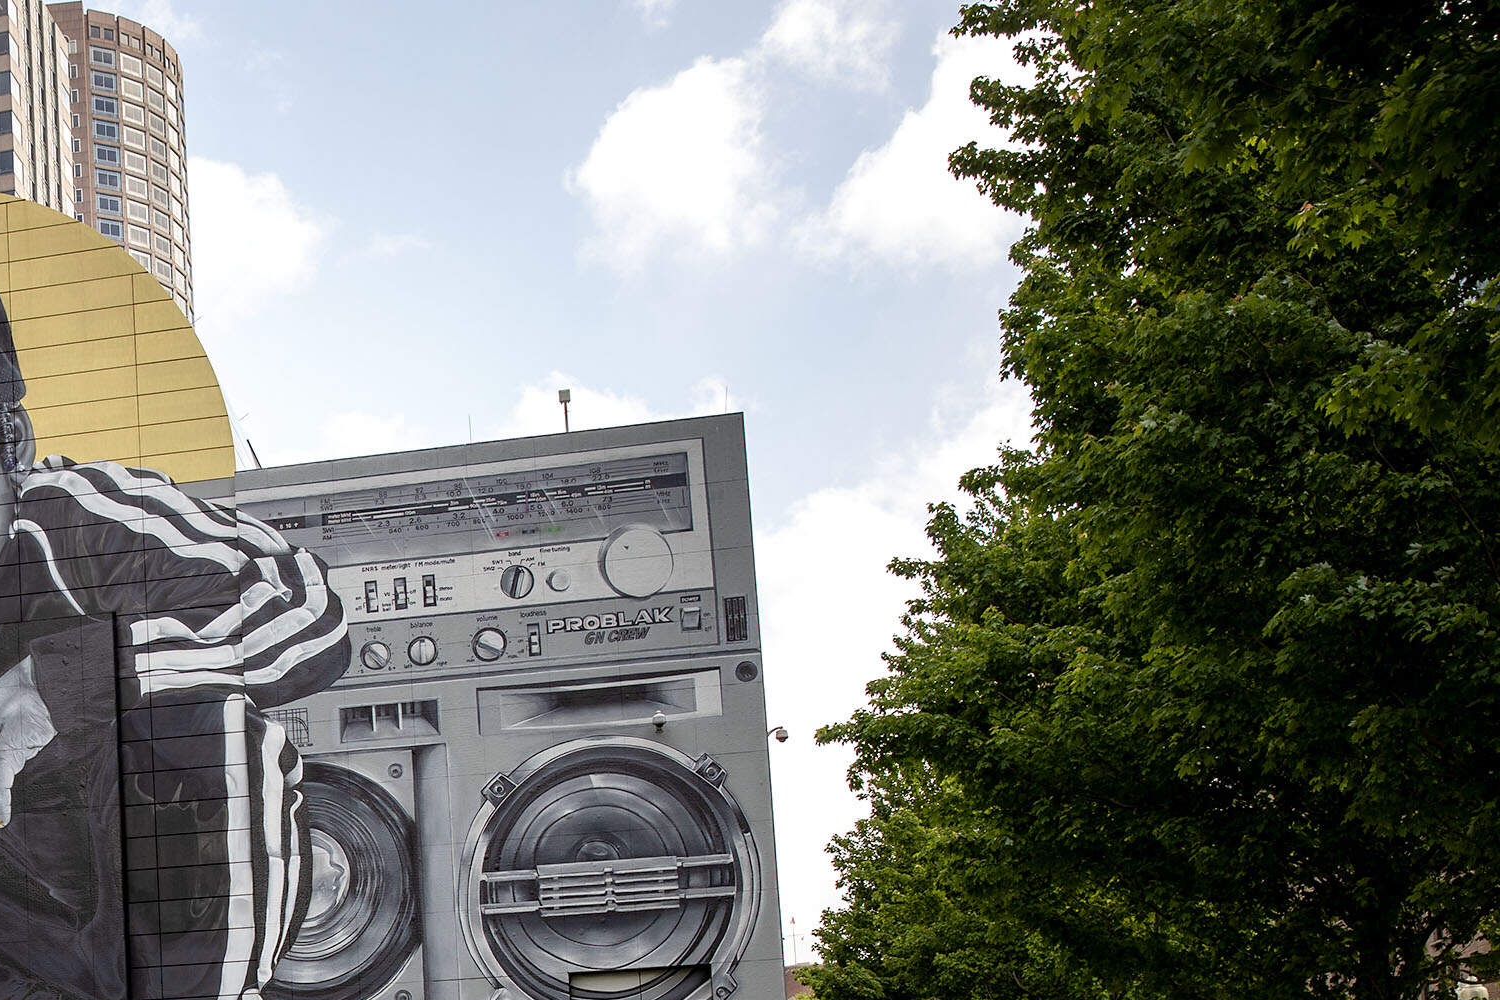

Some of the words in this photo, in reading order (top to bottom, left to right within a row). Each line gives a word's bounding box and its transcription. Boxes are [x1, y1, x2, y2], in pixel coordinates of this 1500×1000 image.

[507, 513, 524, 521] 1000
[379, 520, 390, 528] 2.3
[520, 610, 547, 618] loudness
[410, 620, 433, 629] balance
[547, 606, 673, 635] PROBLAK
[366, 625, 382, 633] treble
[584, 632, 605, 646] GN
[607, 627, 650, 643] CREW
